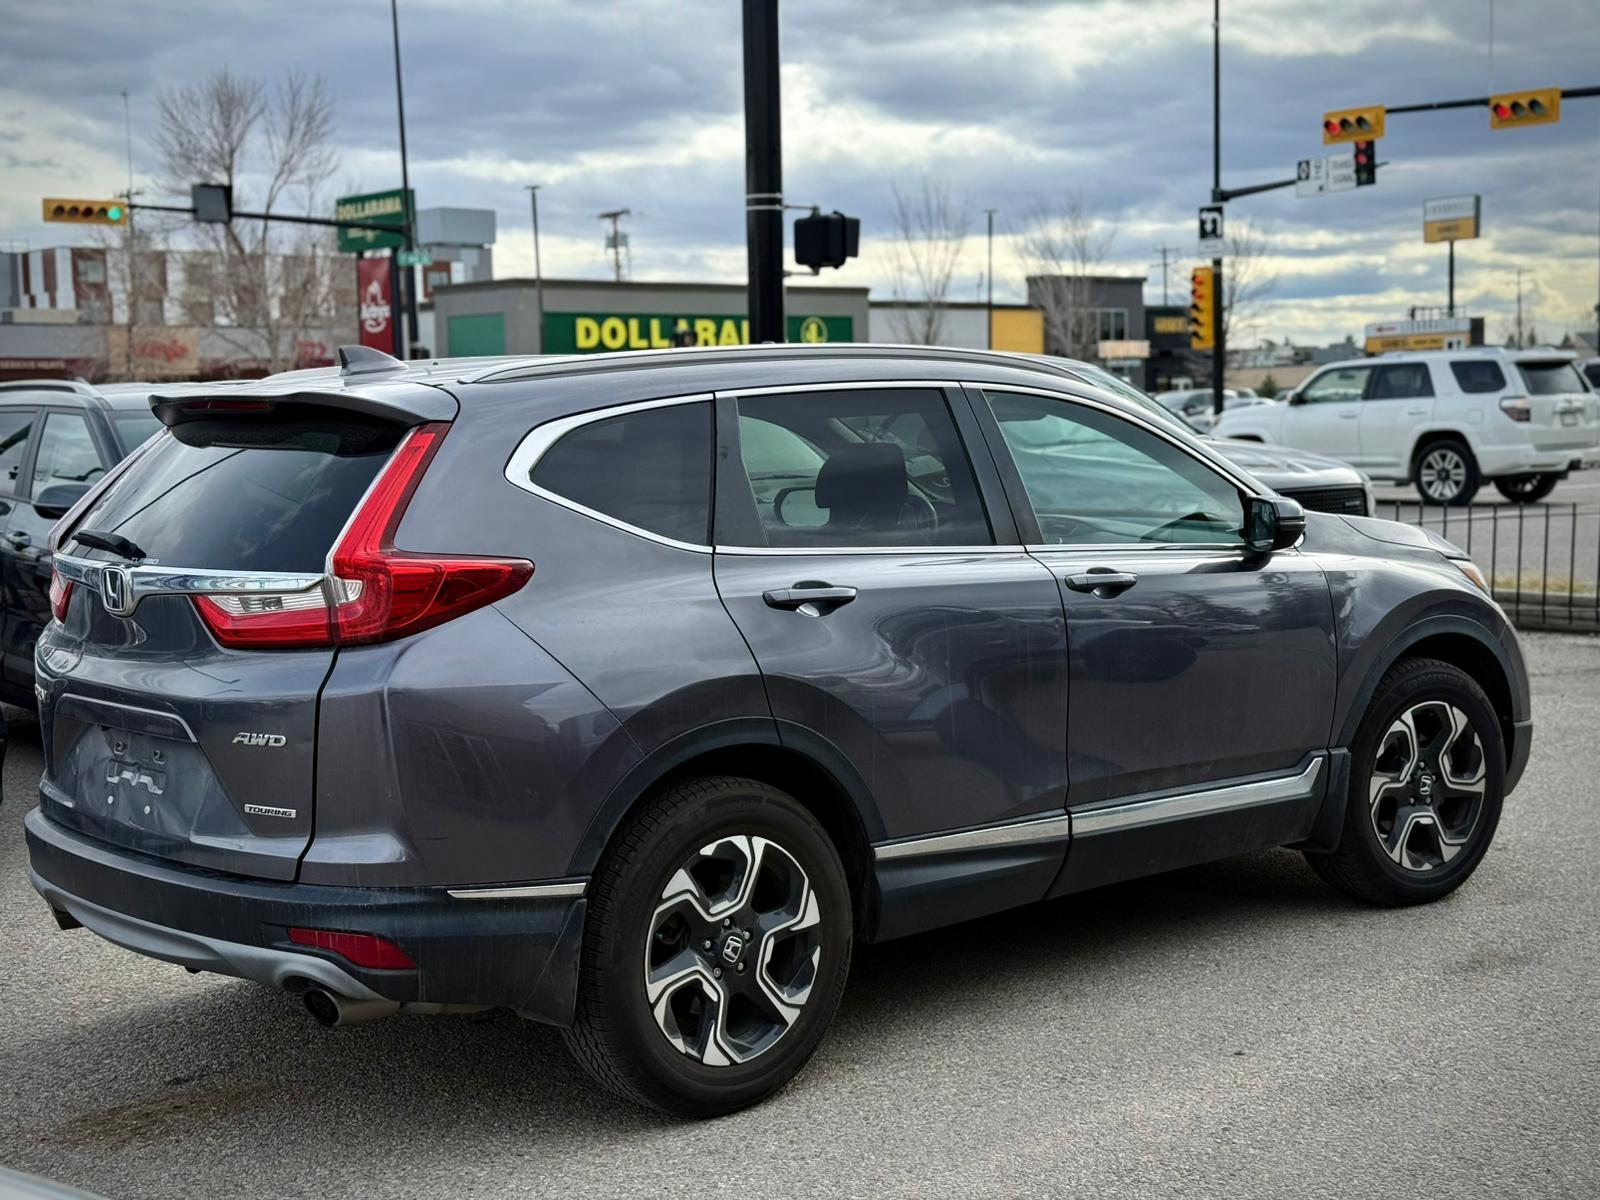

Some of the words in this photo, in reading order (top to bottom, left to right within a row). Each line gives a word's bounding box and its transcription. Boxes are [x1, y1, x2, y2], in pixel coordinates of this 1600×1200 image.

[575, 317, 749, 350] DOLLRA
[232, 732, 287, 747] AWD
[246, 804, 294, 818] TOURING
